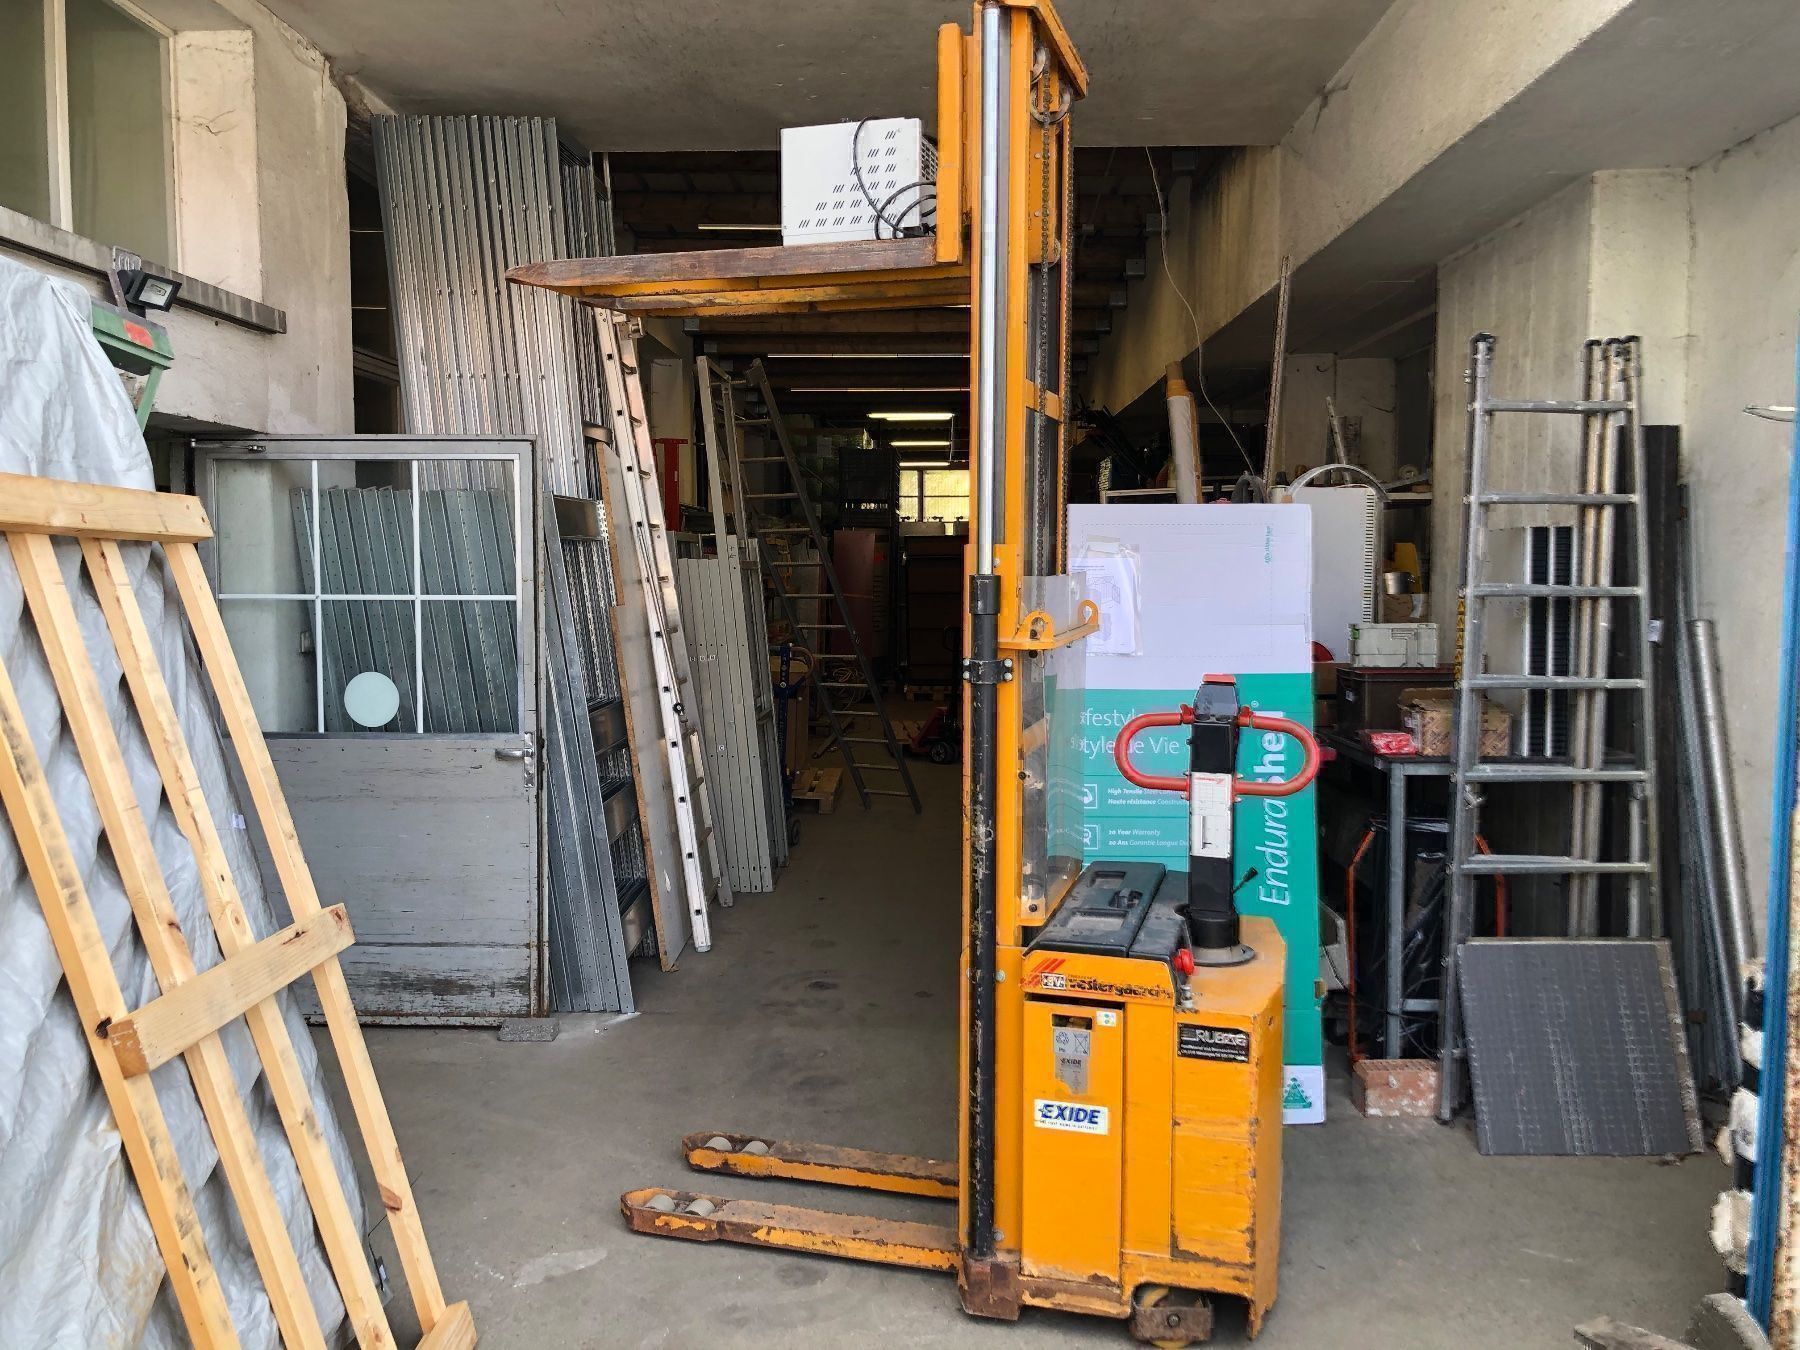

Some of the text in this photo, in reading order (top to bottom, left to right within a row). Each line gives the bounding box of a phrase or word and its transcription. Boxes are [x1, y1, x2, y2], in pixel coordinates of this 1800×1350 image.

[1149, 736, 1180, 754] Vie
[1108, 788, 1122, 796] High
[1132, 829, 1161, 837] Warranty
[1060, 1057, 1082, 1067] EXIDE
[1038, 1103, 1101, 1125] EXIDE
